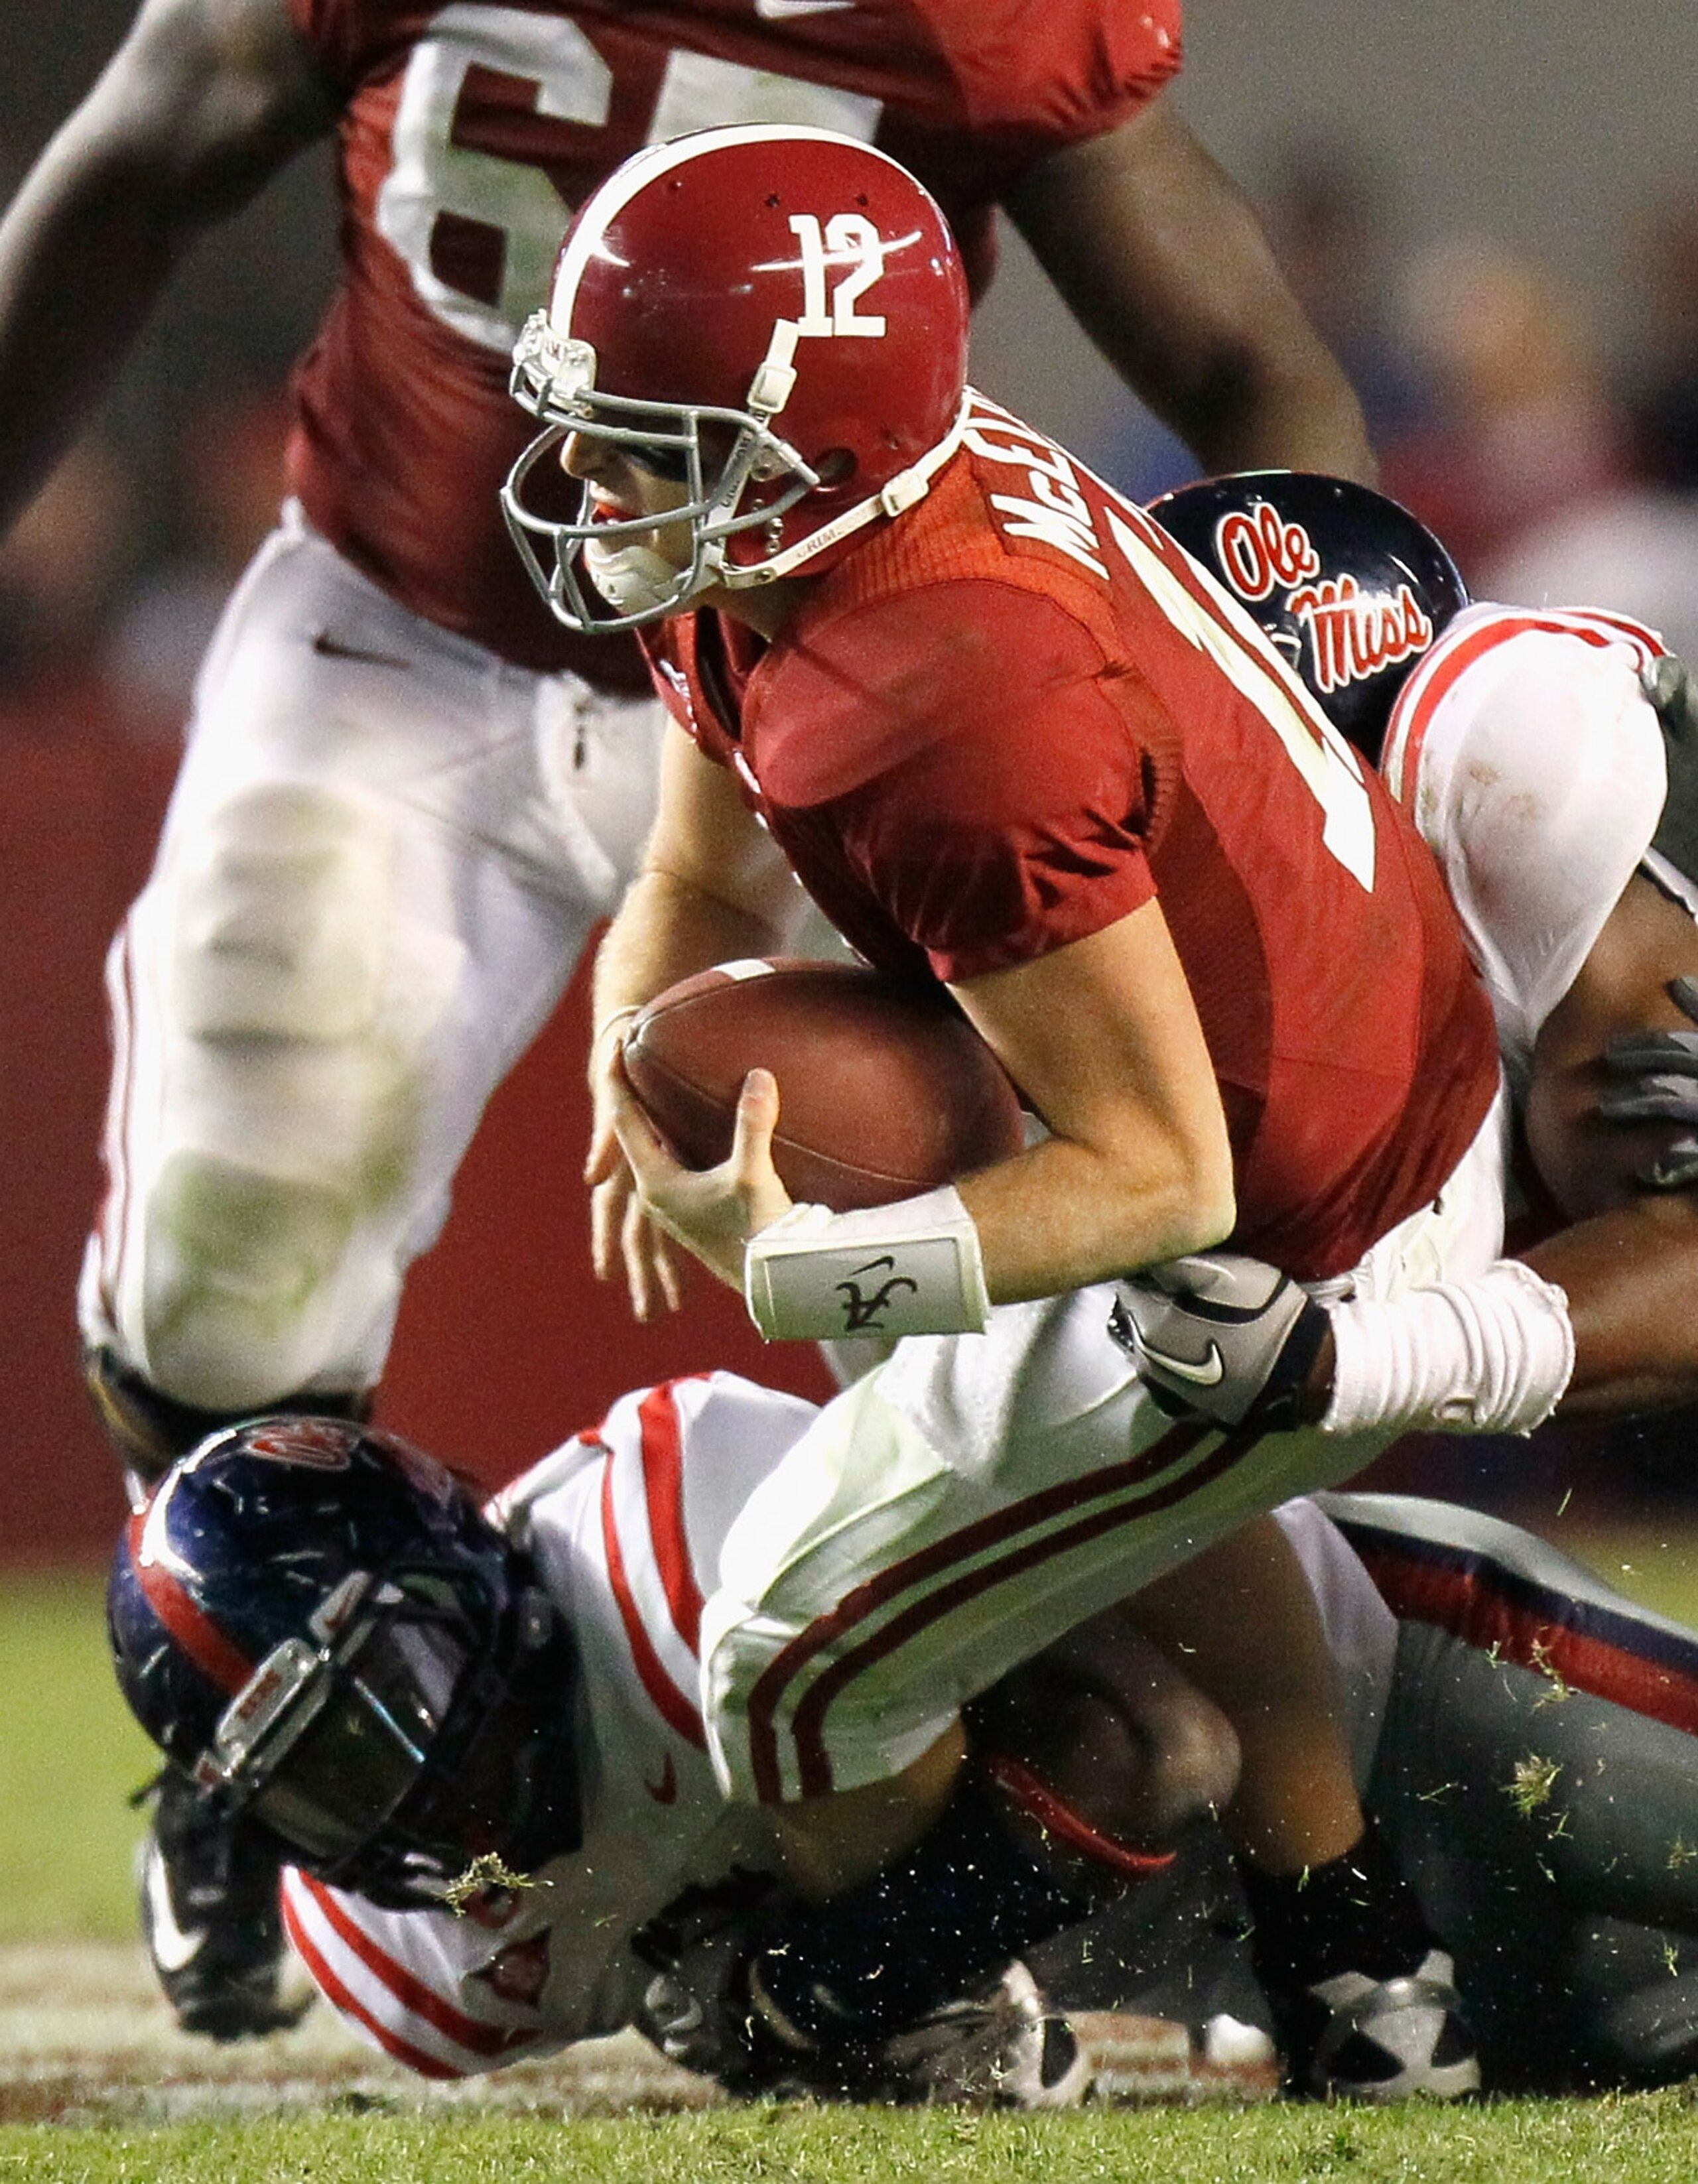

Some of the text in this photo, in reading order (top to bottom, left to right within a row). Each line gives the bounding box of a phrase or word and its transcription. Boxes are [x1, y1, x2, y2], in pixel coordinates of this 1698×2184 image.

[789, 214, 885, 337] 12
[1216, 502, 1319, 602] Ole
[1287, 573, 1432, 694] Miss
